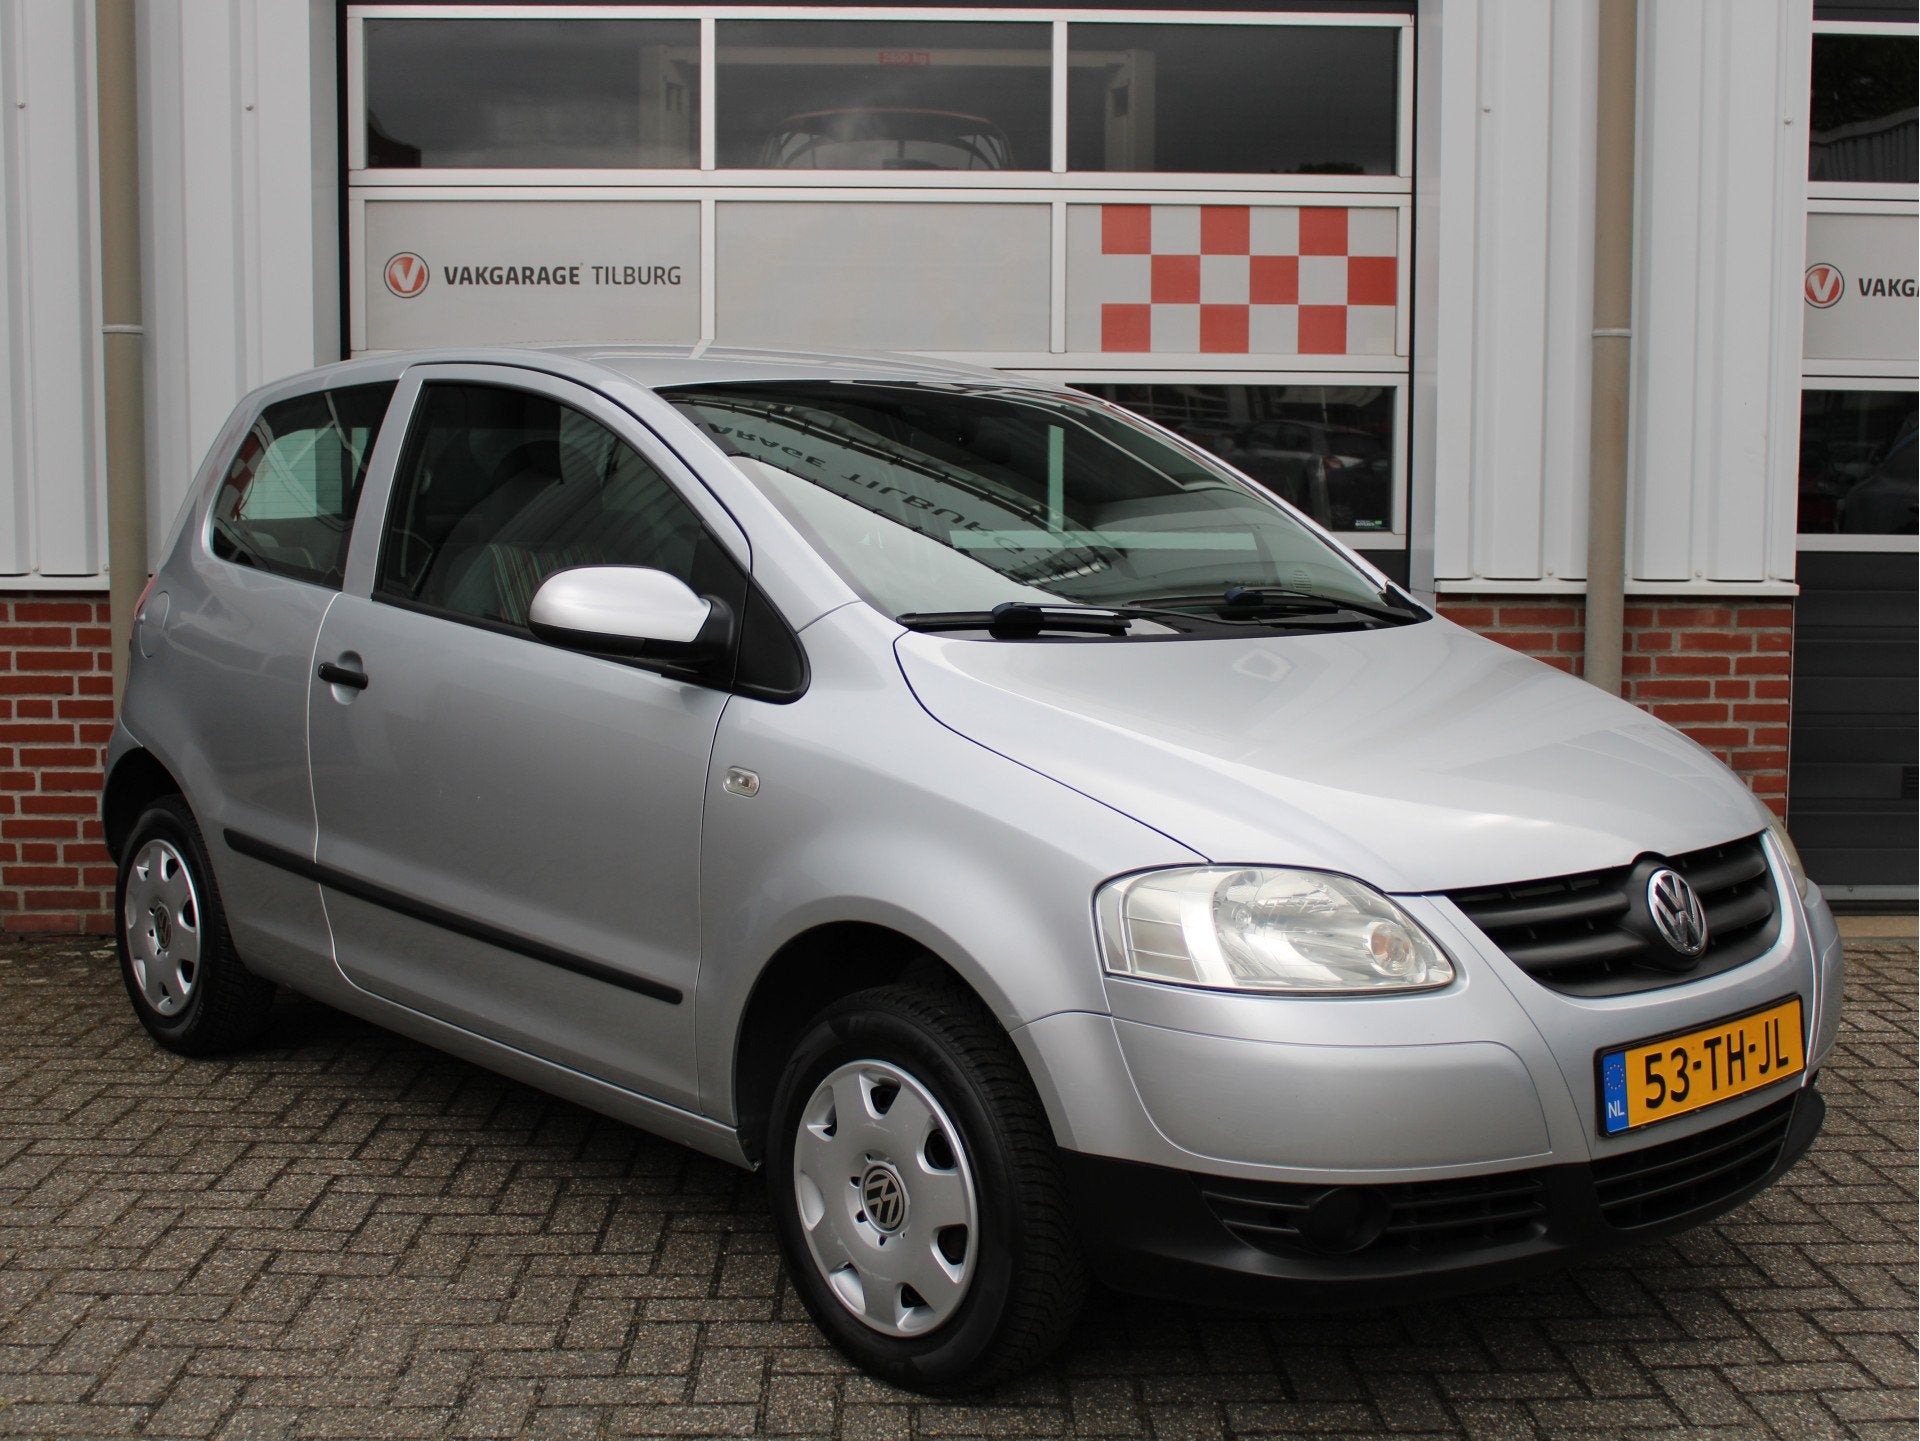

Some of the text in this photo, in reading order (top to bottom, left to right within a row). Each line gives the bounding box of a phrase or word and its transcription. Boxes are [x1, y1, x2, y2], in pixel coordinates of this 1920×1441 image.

[443, 265, 580, 286] VAKGARAGE
[591, 265, 681, 286] TILBURG
[1858, 278, 1919, 298] VAKG
[1644, 1018, 1789, 1109] 53-TH-JL
[1608, 1100, 1625, 1119] NL
